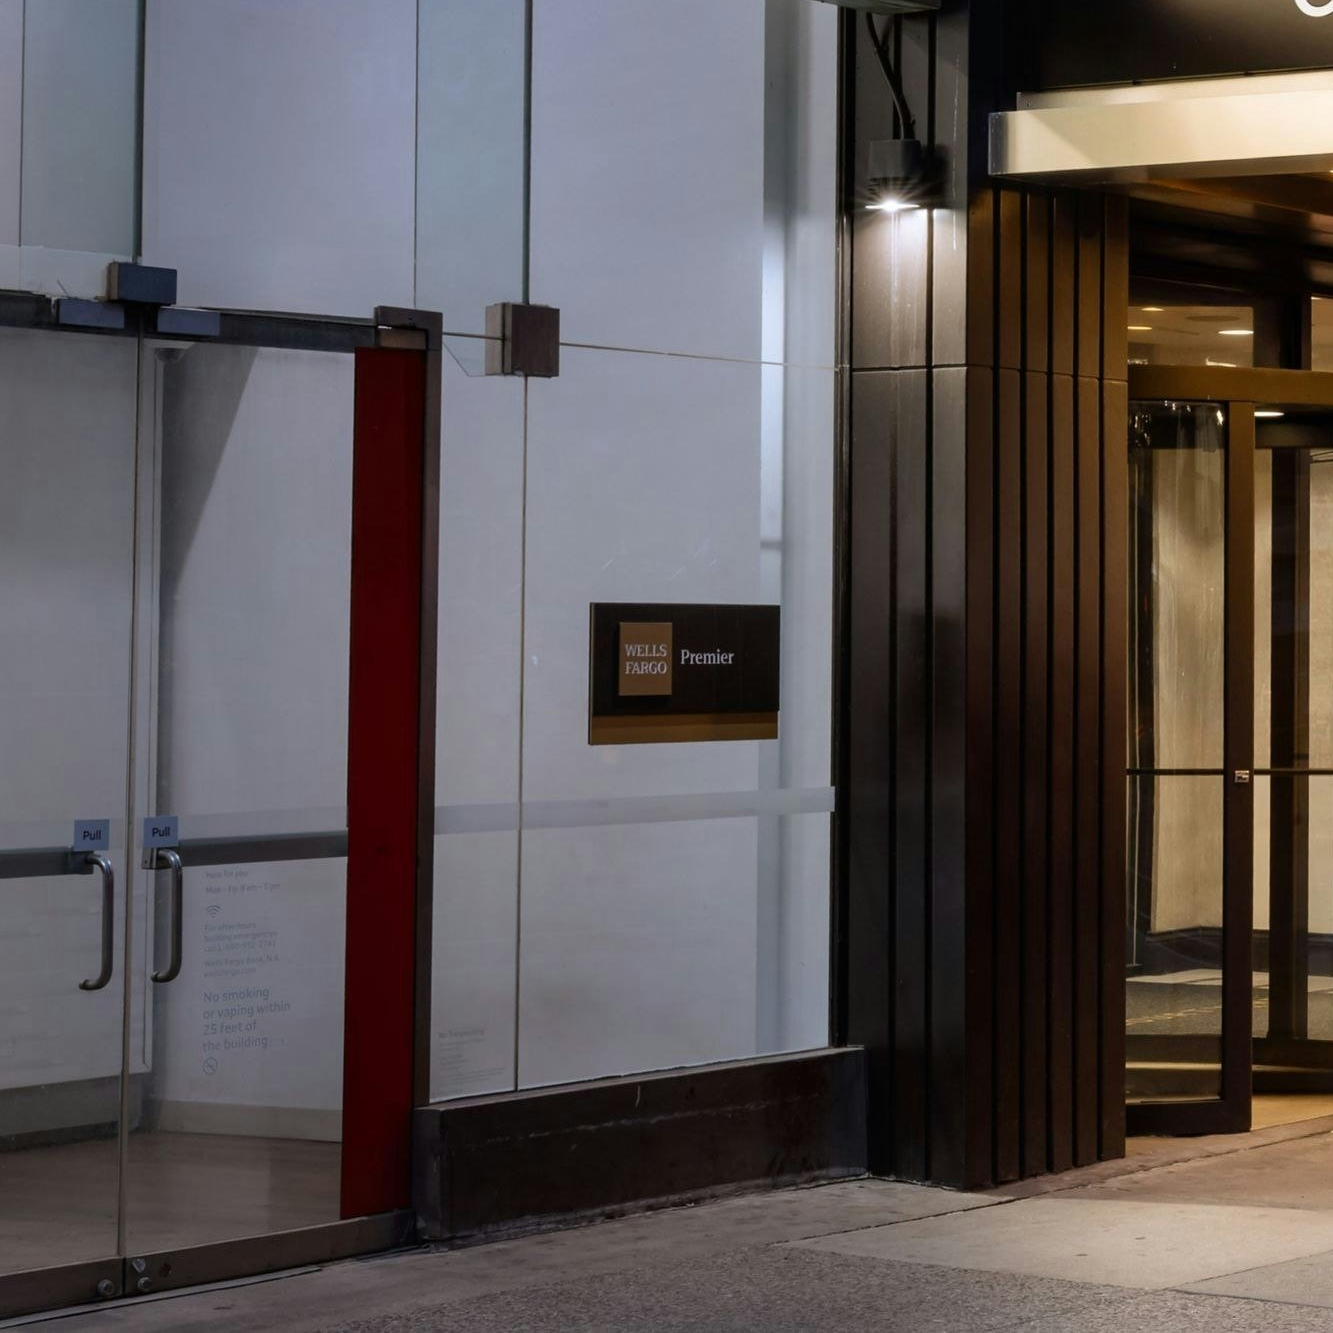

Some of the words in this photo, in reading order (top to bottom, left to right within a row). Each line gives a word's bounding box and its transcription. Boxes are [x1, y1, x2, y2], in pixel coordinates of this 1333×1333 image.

[624, 644, 668, 657] WELLS
[680, 649, 735, 665] Premier
[624, 661, 667, 675] FARGO
[83, 830, 102, 841] Pull
[152, 827, 171, 837] Pull
[203, 992, 220, 1003] No
[222, 987, 270, 1002] smoking
[203, 1010, 216, 1020] or
[217, 1005, 254, 1020] vaping
[256, 1000, 290, 1014] within
[203, 1023, 218, 1036] 25
[220, 1021, 243, 1033] feet
[244, 1020, 257, 1032] of
[203, 1040, 221, 1052] the
[223, 1035, 268, 1051] building
